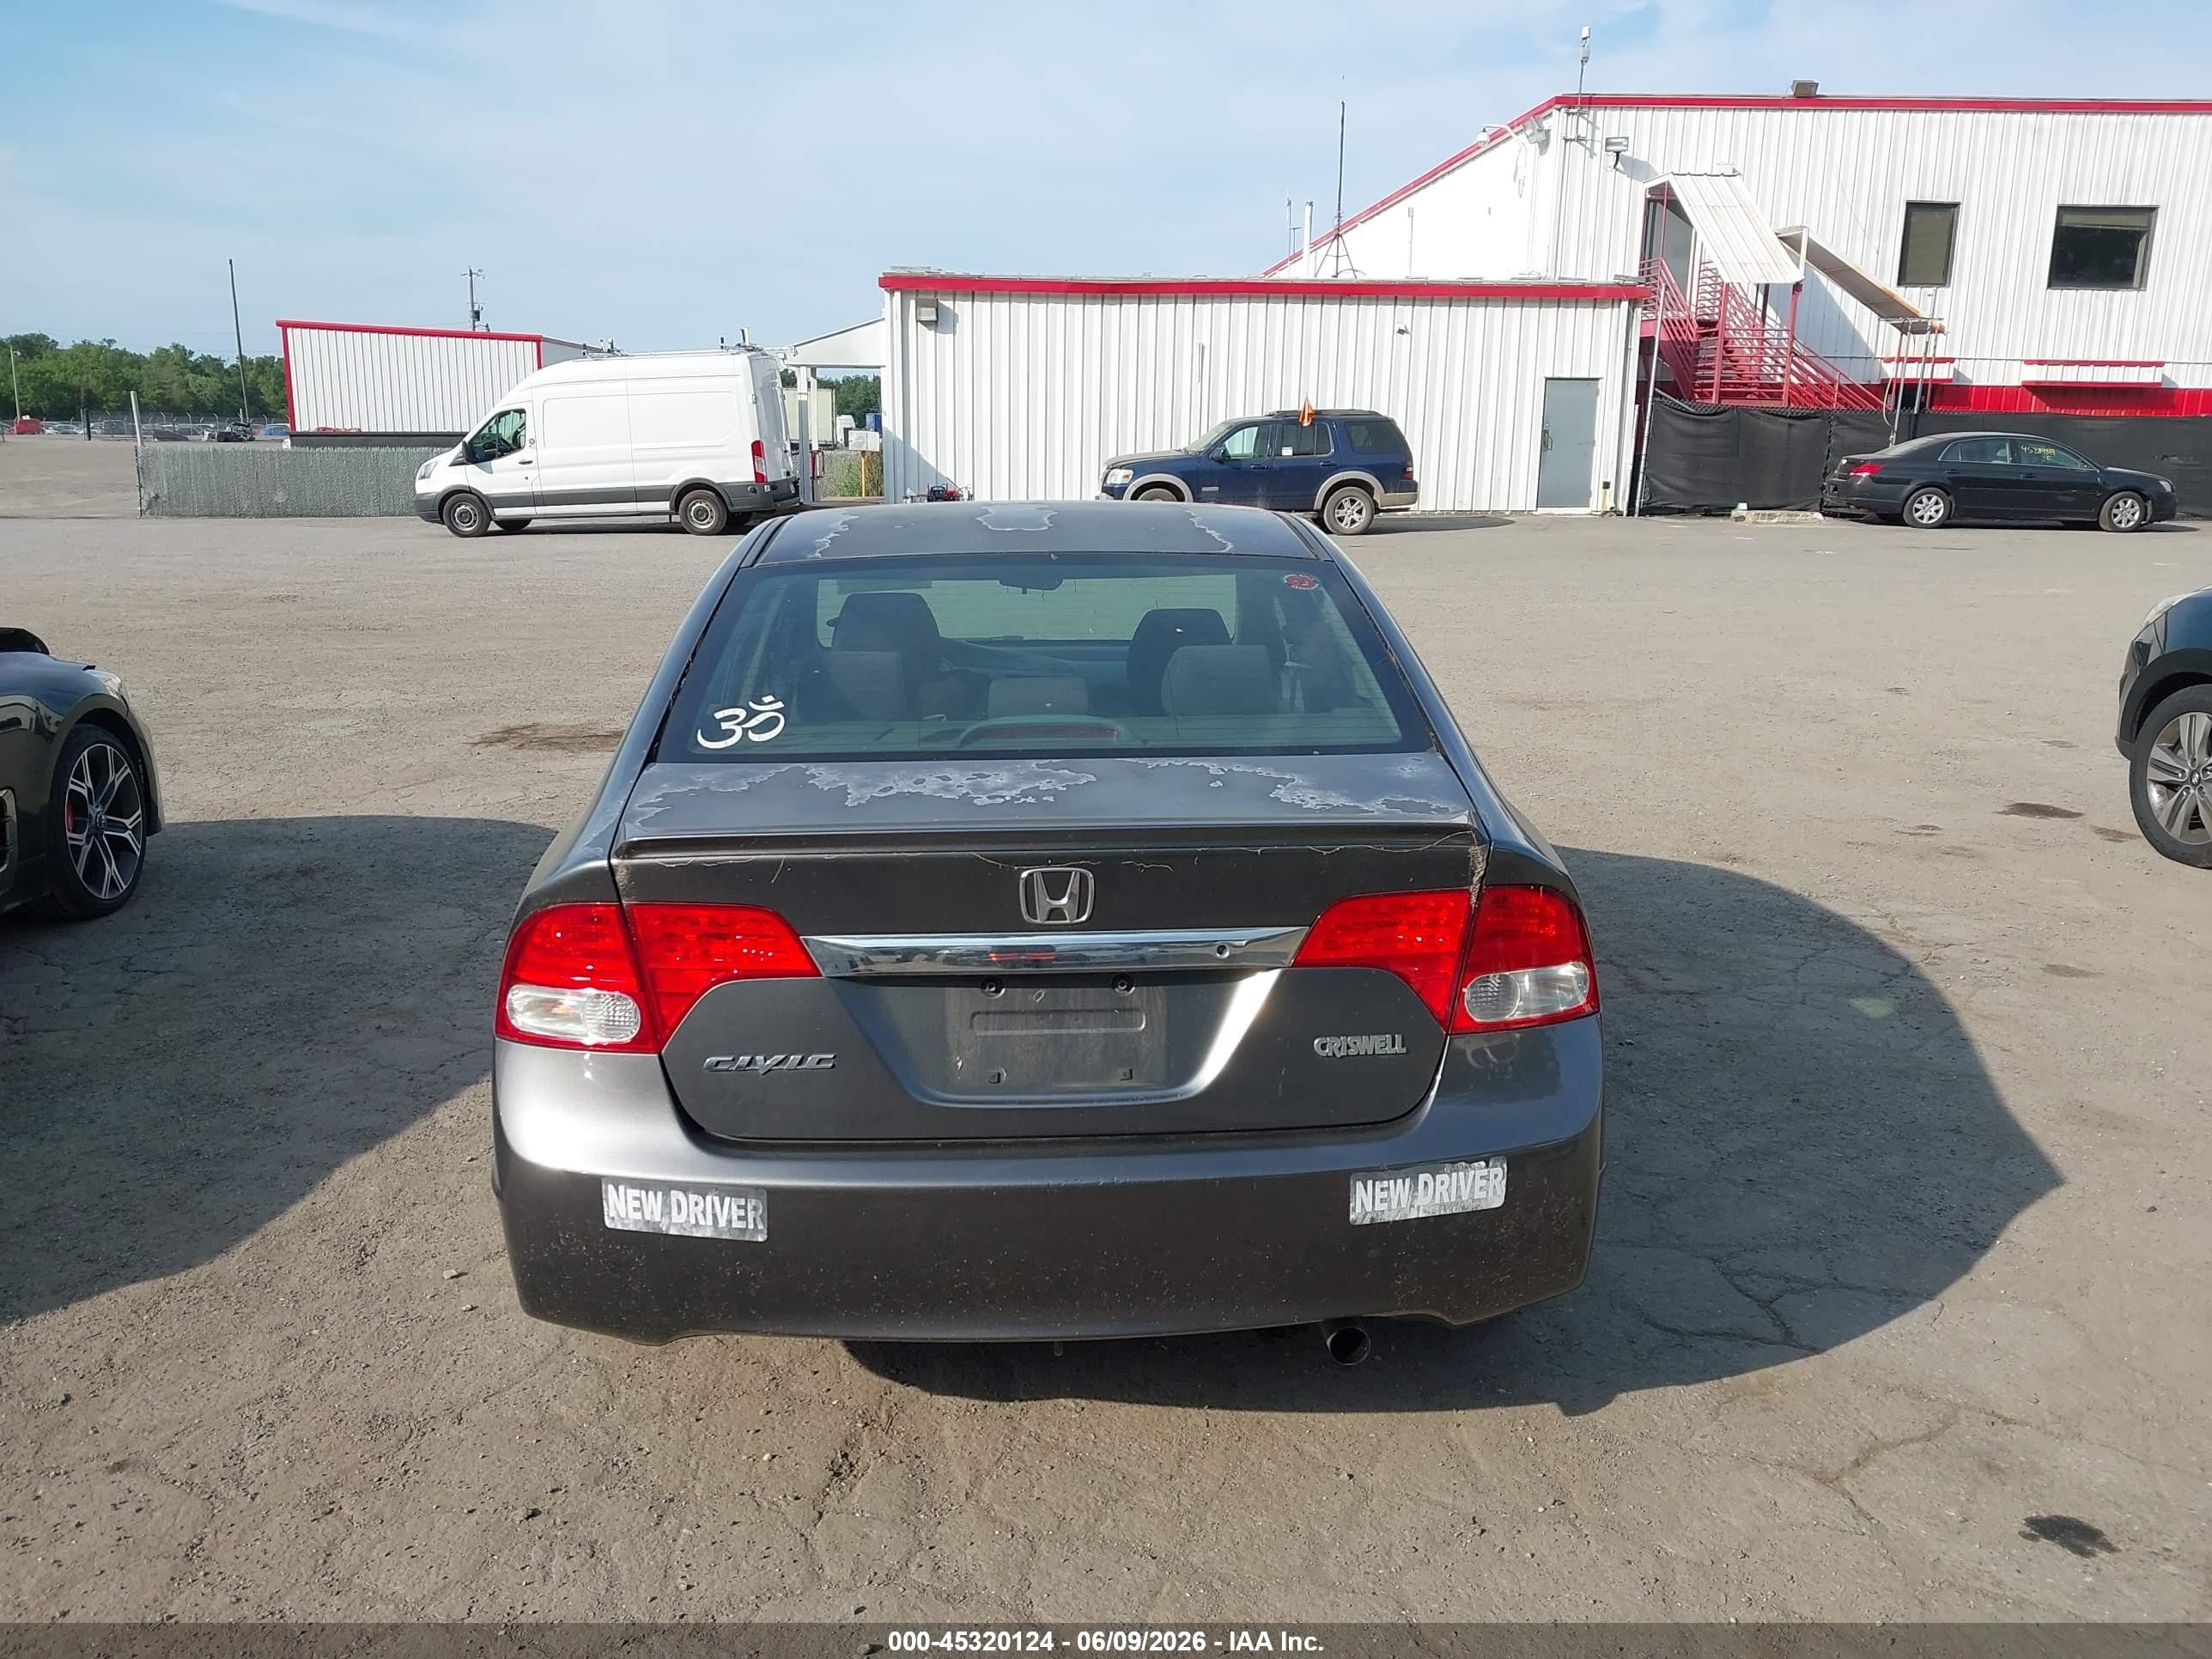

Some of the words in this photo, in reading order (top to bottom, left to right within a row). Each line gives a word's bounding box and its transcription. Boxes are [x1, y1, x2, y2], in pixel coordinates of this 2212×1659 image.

[703, 1054, 836, 1075] CIVIC
[607, 1183, 663, 1222] NEW
[670, 1190, 764, 1230] DRIVER
[1356, 1177, 1410, 1213] NEW
[1417, 1167, 1504, 1205] DRIVER
